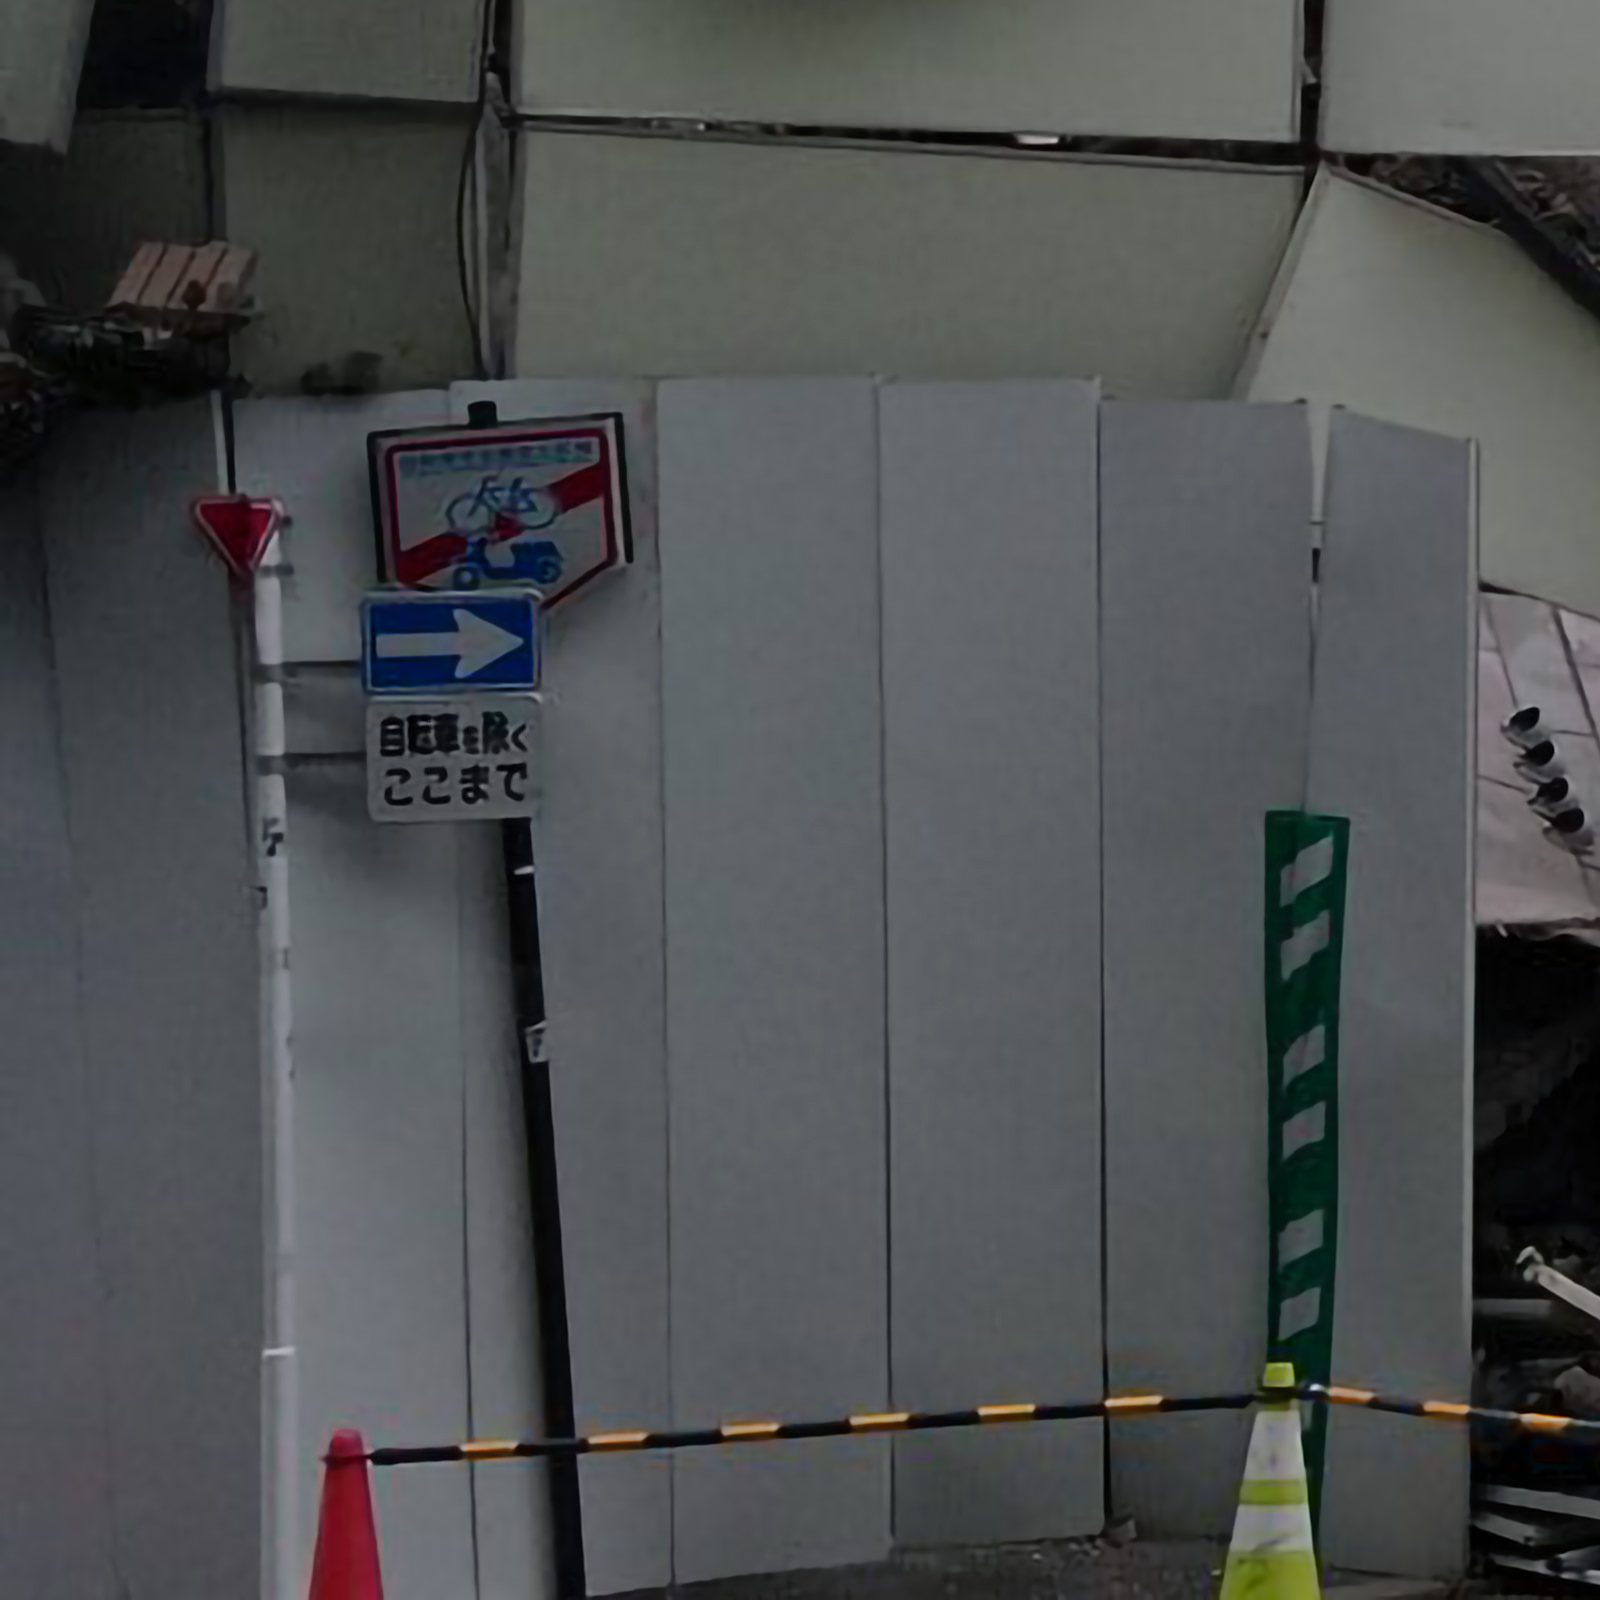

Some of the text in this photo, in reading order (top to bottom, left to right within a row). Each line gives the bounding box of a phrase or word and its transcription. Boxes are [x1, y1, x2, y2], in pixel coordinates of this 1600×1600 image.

[380, 712, 528, 757] 自転車を除く
[384, 763, 528, 806] ここまで
